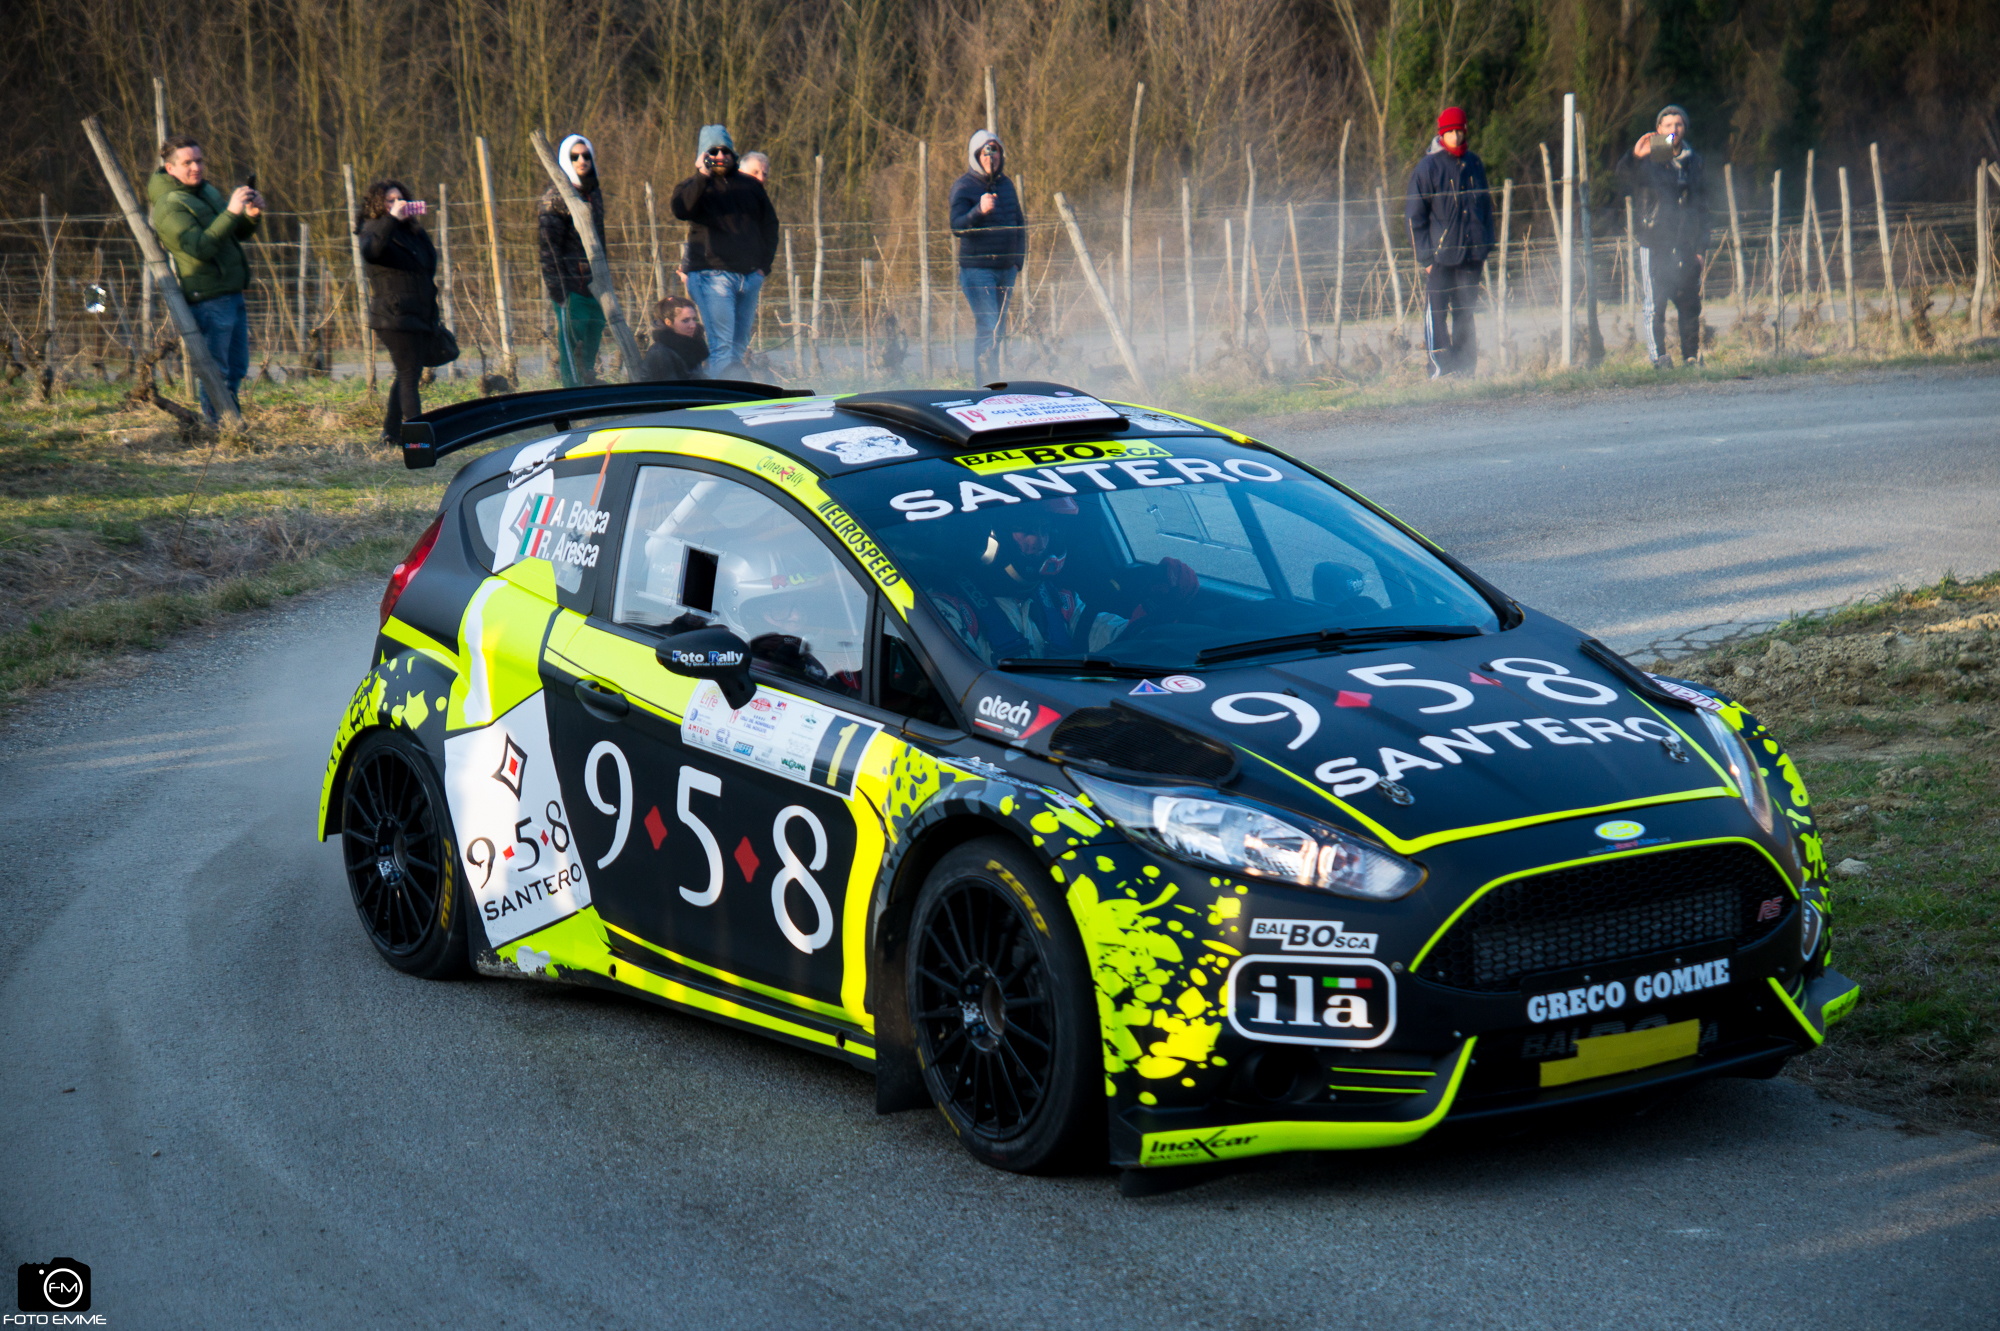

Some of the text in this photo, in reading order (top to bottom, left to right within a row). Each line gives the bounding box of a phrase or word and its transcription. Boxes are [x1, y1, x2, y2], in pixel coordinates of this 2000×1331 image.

[1006, 414, 1089, 426] CONCORRENTE
[890, 458, 1284, 521] SANTERO
[549, 498, 610, 534] A. Bosca
[535, 530, 600, 567] R. Aresca
[823, 506, 902, 587] EUROSPEED
[672, 650, 744, 665] Foto Rally
[700, 692, 718, 710] Life
[979, 695, 1032, 727] atech
[688, 724, 710, 736] AMERIO
[826, 722, 860, 788] 1
[1315, 716, 1682, 797] SANTERO
[483, 862, 584, 921] SANTERO
[1757, 896, 1783, 923] RS
[1527, 958, 1730, 1023] GRECO GOMME
